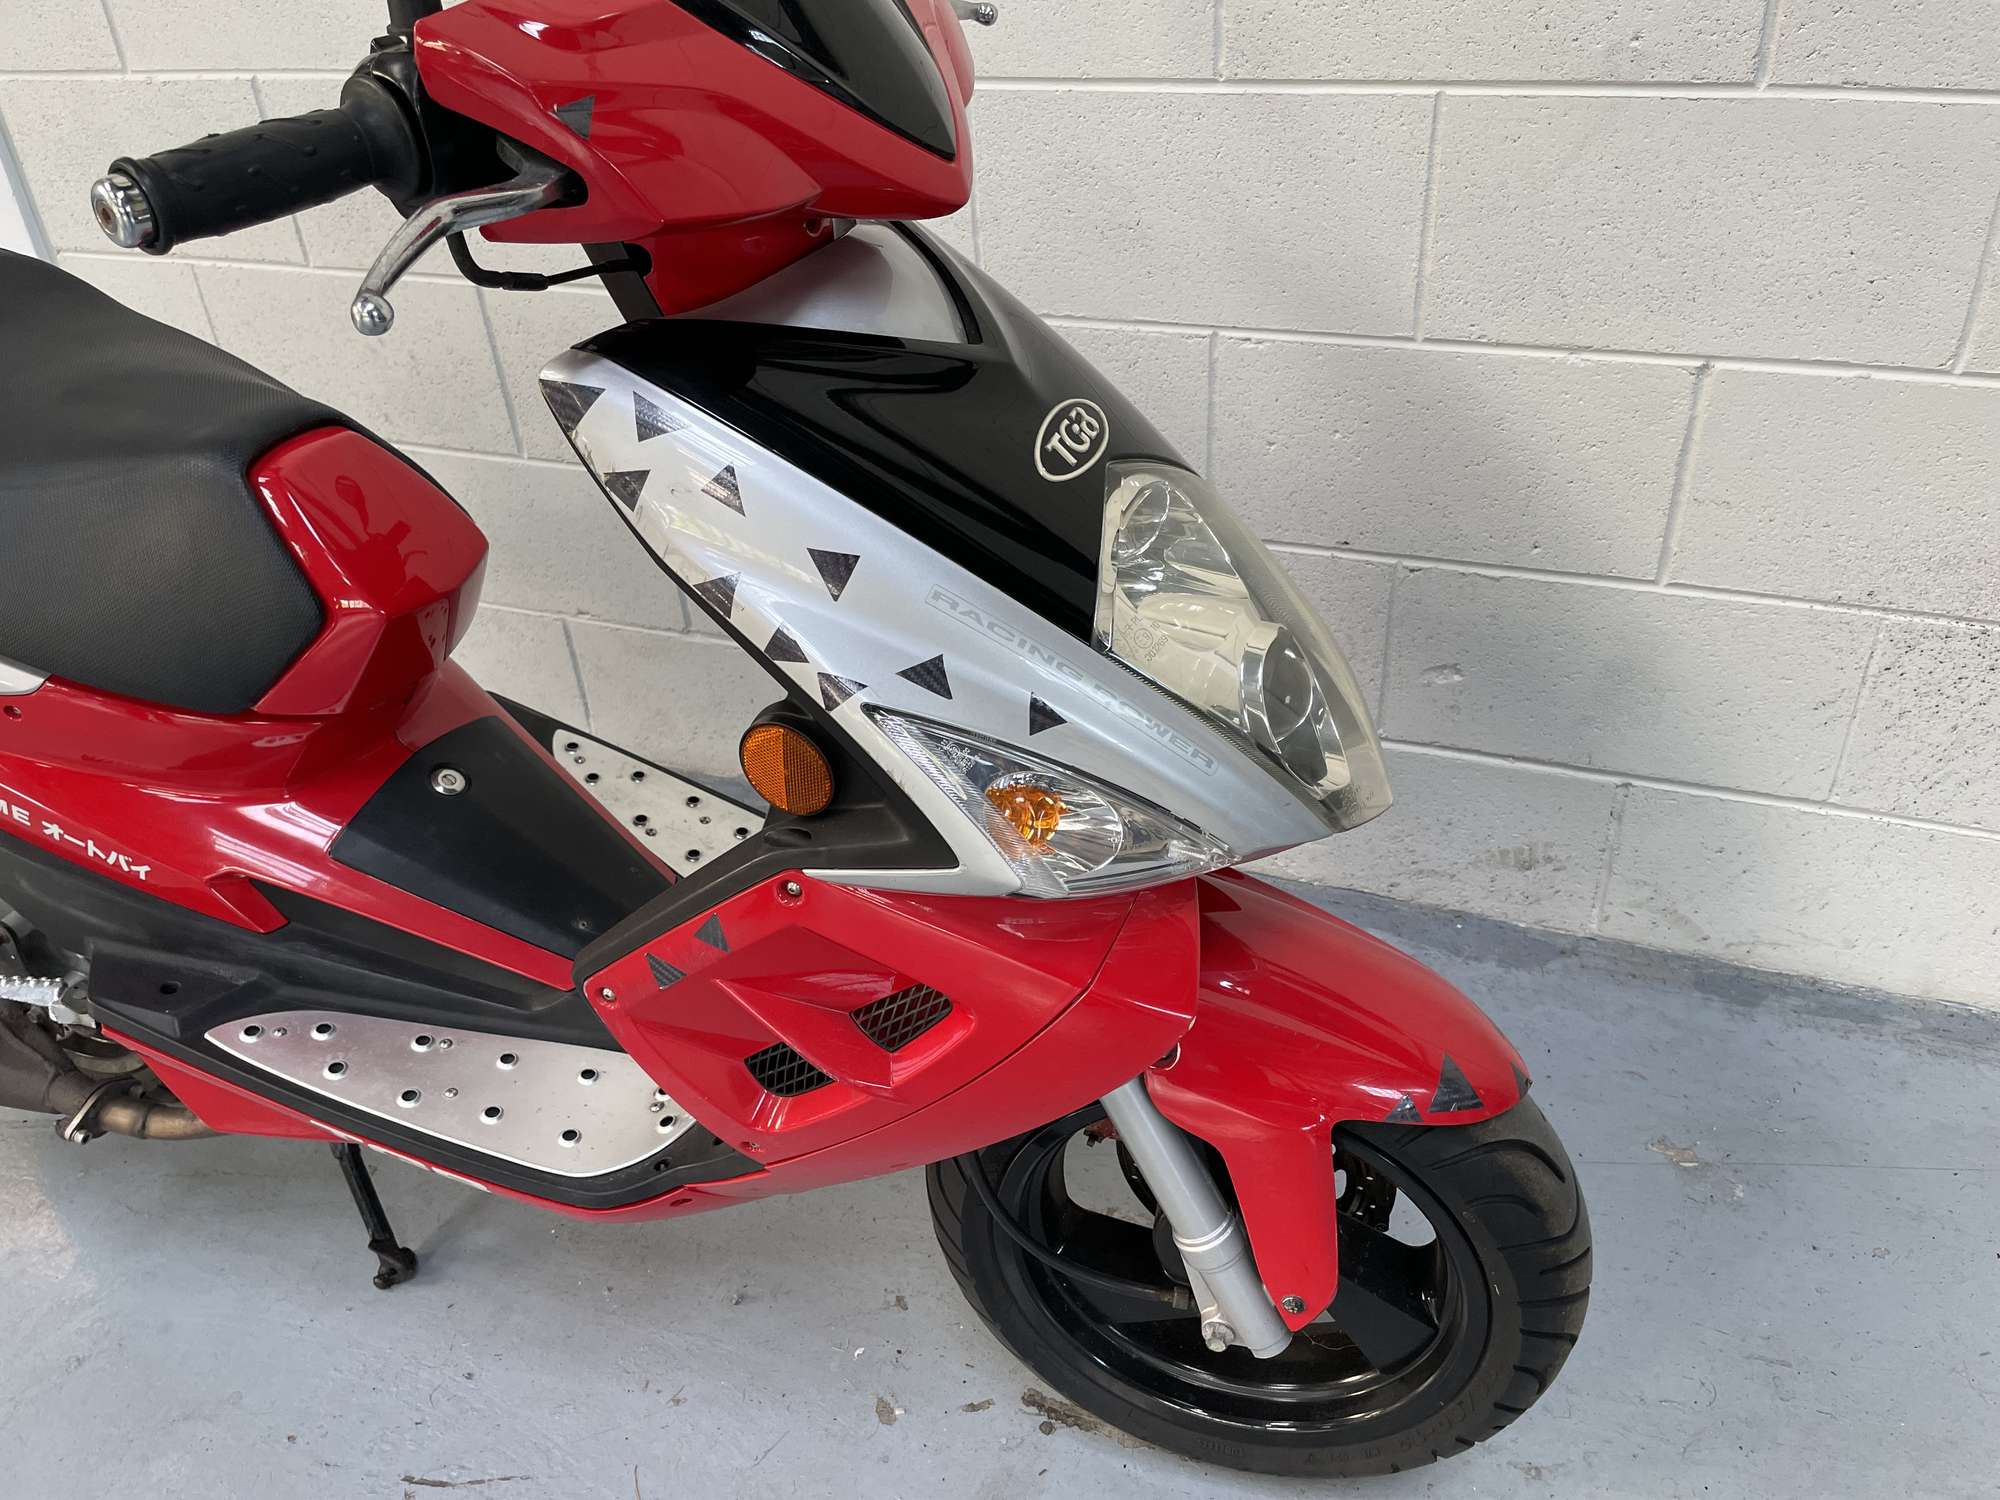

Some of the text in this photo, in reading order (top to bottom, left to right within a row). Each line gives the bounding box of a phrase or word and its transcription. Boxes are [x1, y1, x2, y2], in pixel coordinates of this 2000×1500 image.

[931, 589, 1214, 769] RACING POWER
[42, 820, 151, 881] オートバイ
